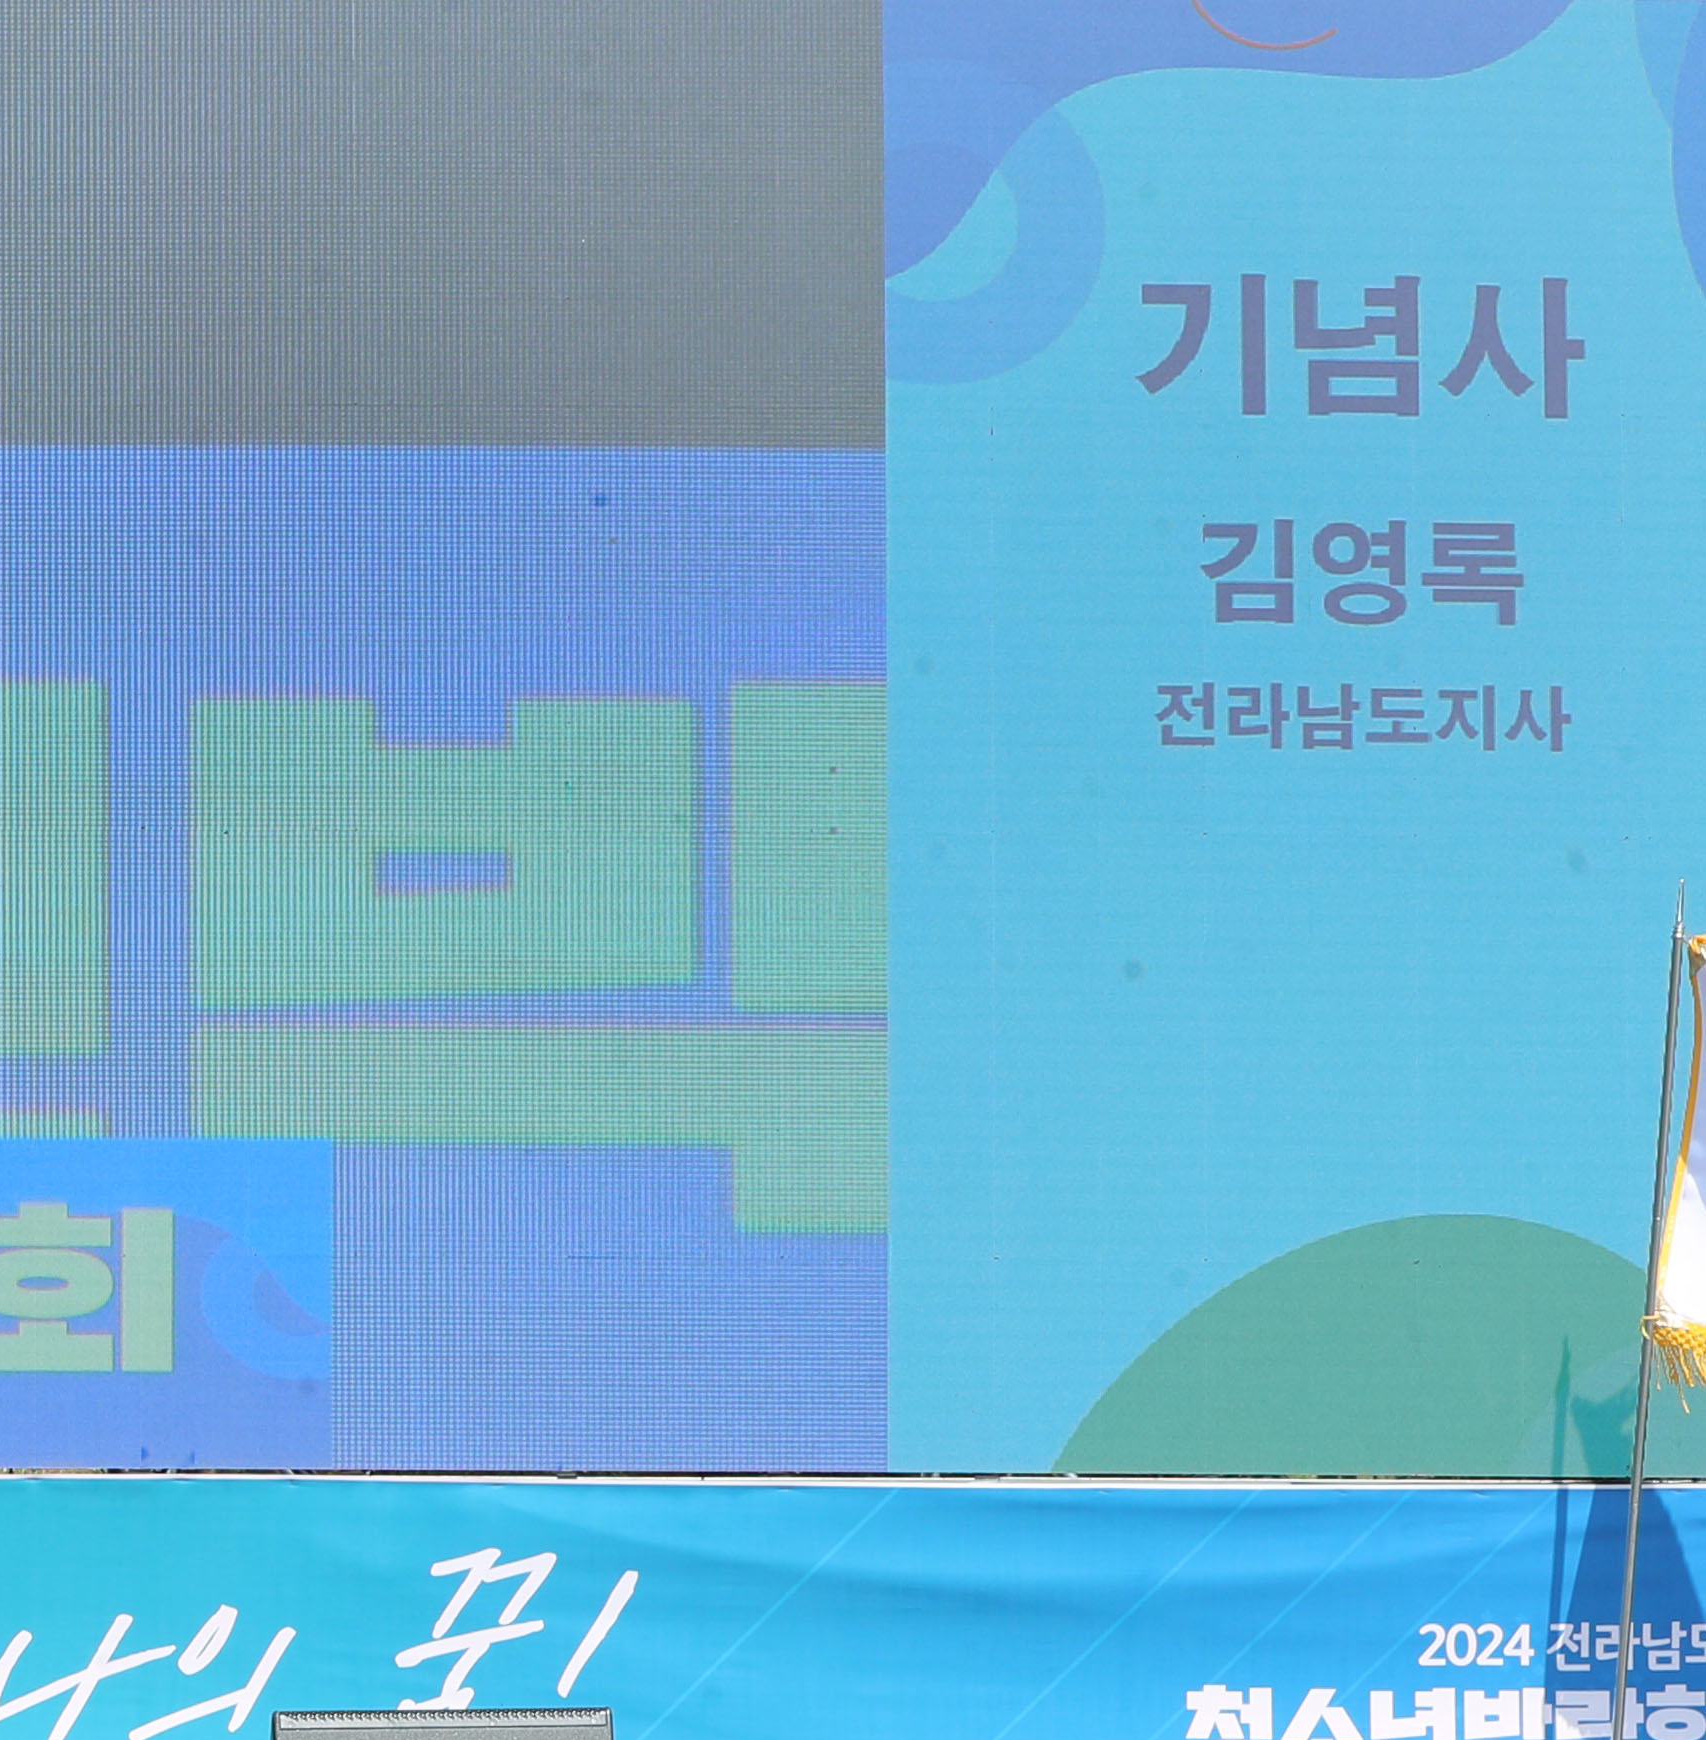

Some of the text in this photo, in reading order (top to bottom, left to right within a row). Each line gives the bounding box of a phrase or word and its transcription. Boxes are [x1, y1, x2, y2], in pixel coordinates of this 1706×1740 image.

[1135, 273, 1586, 419] 기념사
[1199, 518, 1525, 626] 김영록
[1153, 682, 1573, 753] 전라남도지사
[1418, 1622, 1535, 1667] 2024
